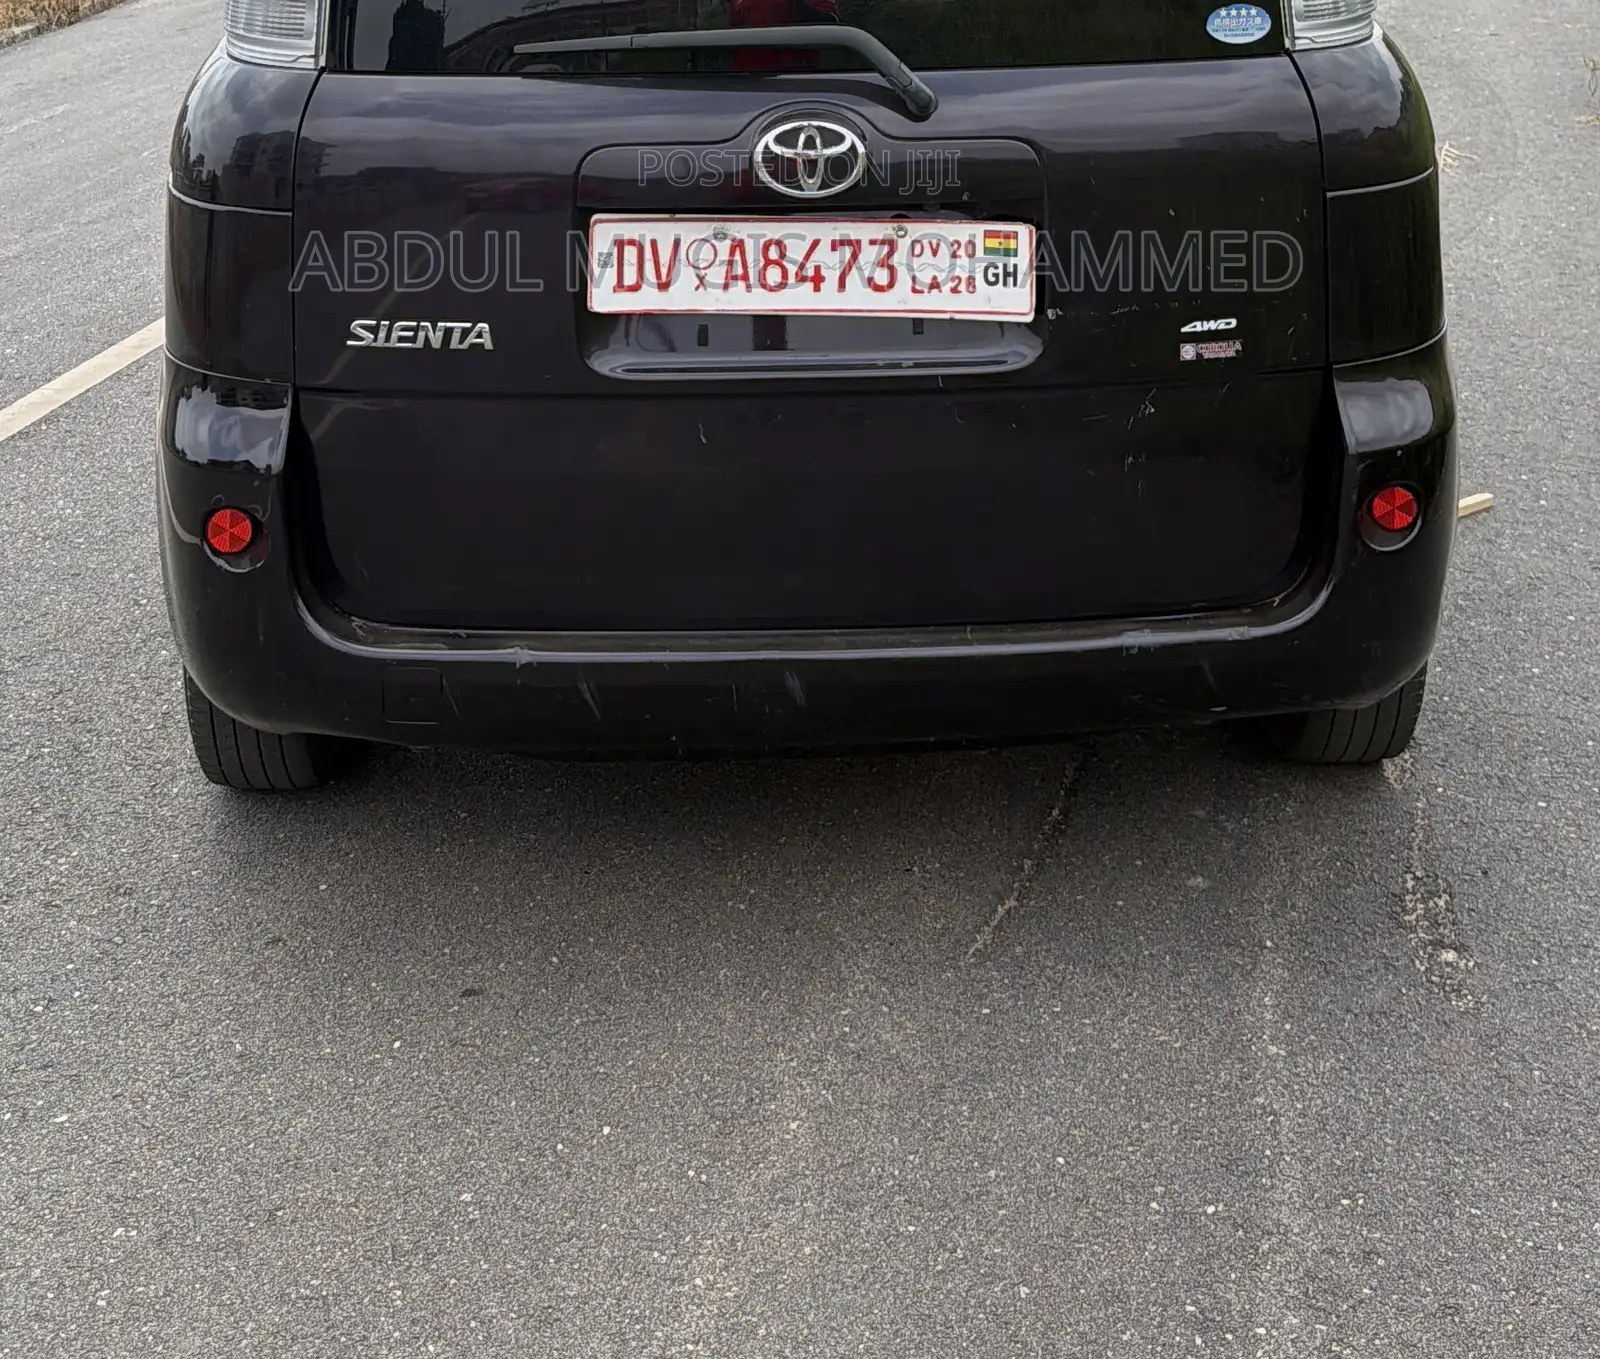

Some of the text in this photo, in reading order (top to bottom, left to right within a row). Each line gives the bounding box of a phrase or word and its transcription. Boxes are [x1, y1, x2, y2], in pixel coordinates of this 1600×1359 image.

[910, 239, 976, 259] DV 20
[612, 237, 682, 294] DV
[722, 237, 899, 293] A8473
[983, 261, 1018, 288] GH
[345, 319, 494, 350] SIENTA
